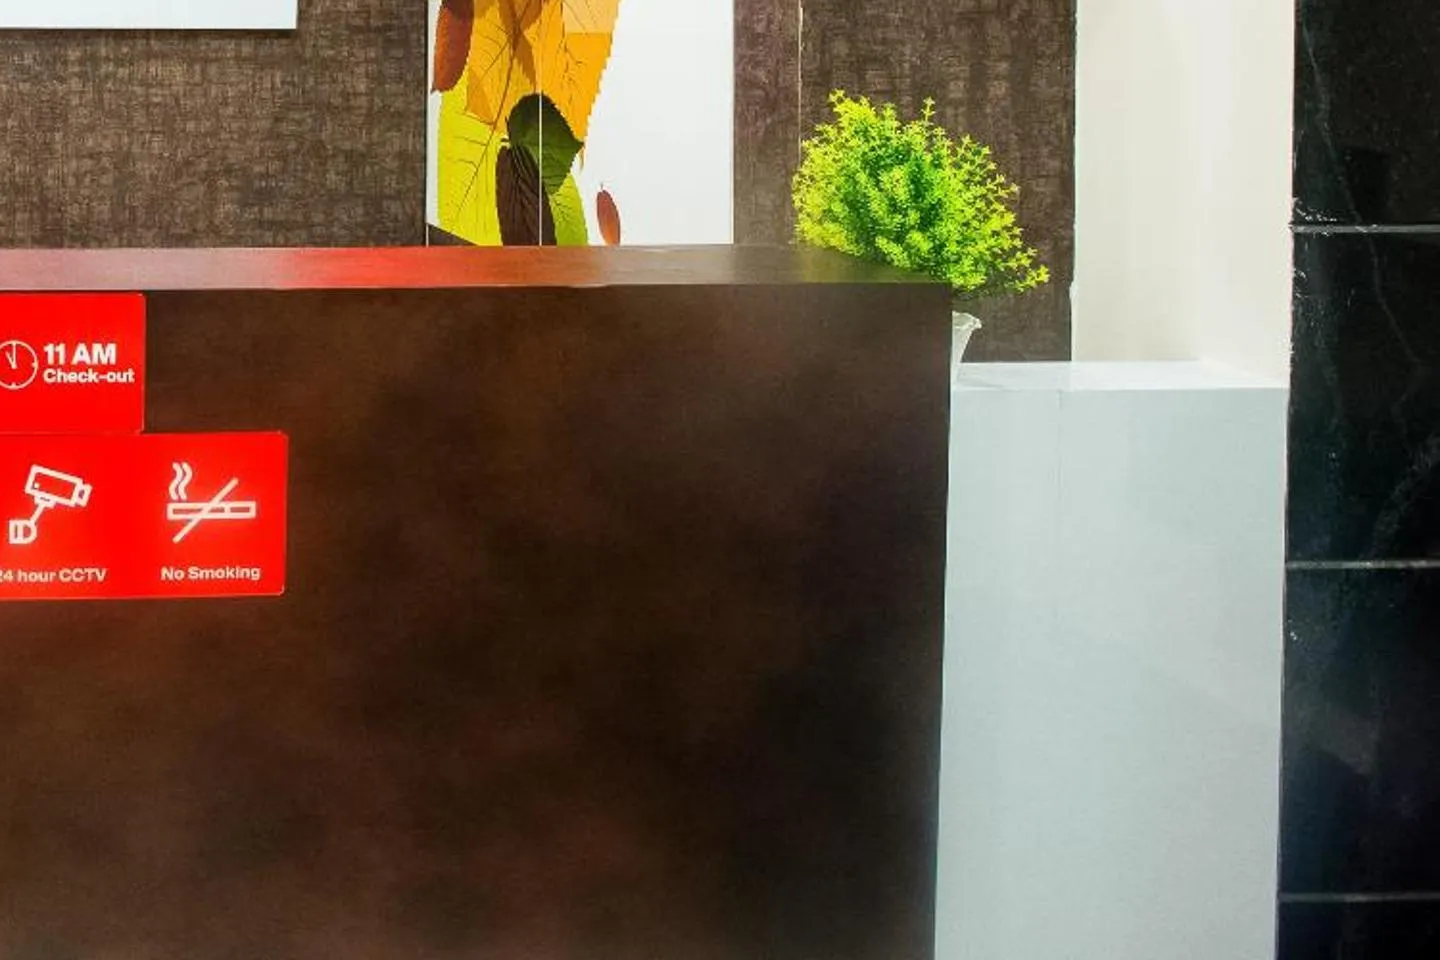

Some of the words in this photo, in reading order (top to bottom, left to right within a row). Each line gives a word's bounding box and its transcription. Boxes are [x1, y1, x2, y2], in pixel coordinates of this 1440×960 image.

[43, 342, 66, 365] 11
[71, 343, 116, 365] AM
[43, 368, 135, 384] Check-out
[17, 568, 57, 583] hour
[59, 567, 107, 583] CCTV
[160, 566, 185, 581] No
[187, 565, 261, 581] Smoking
